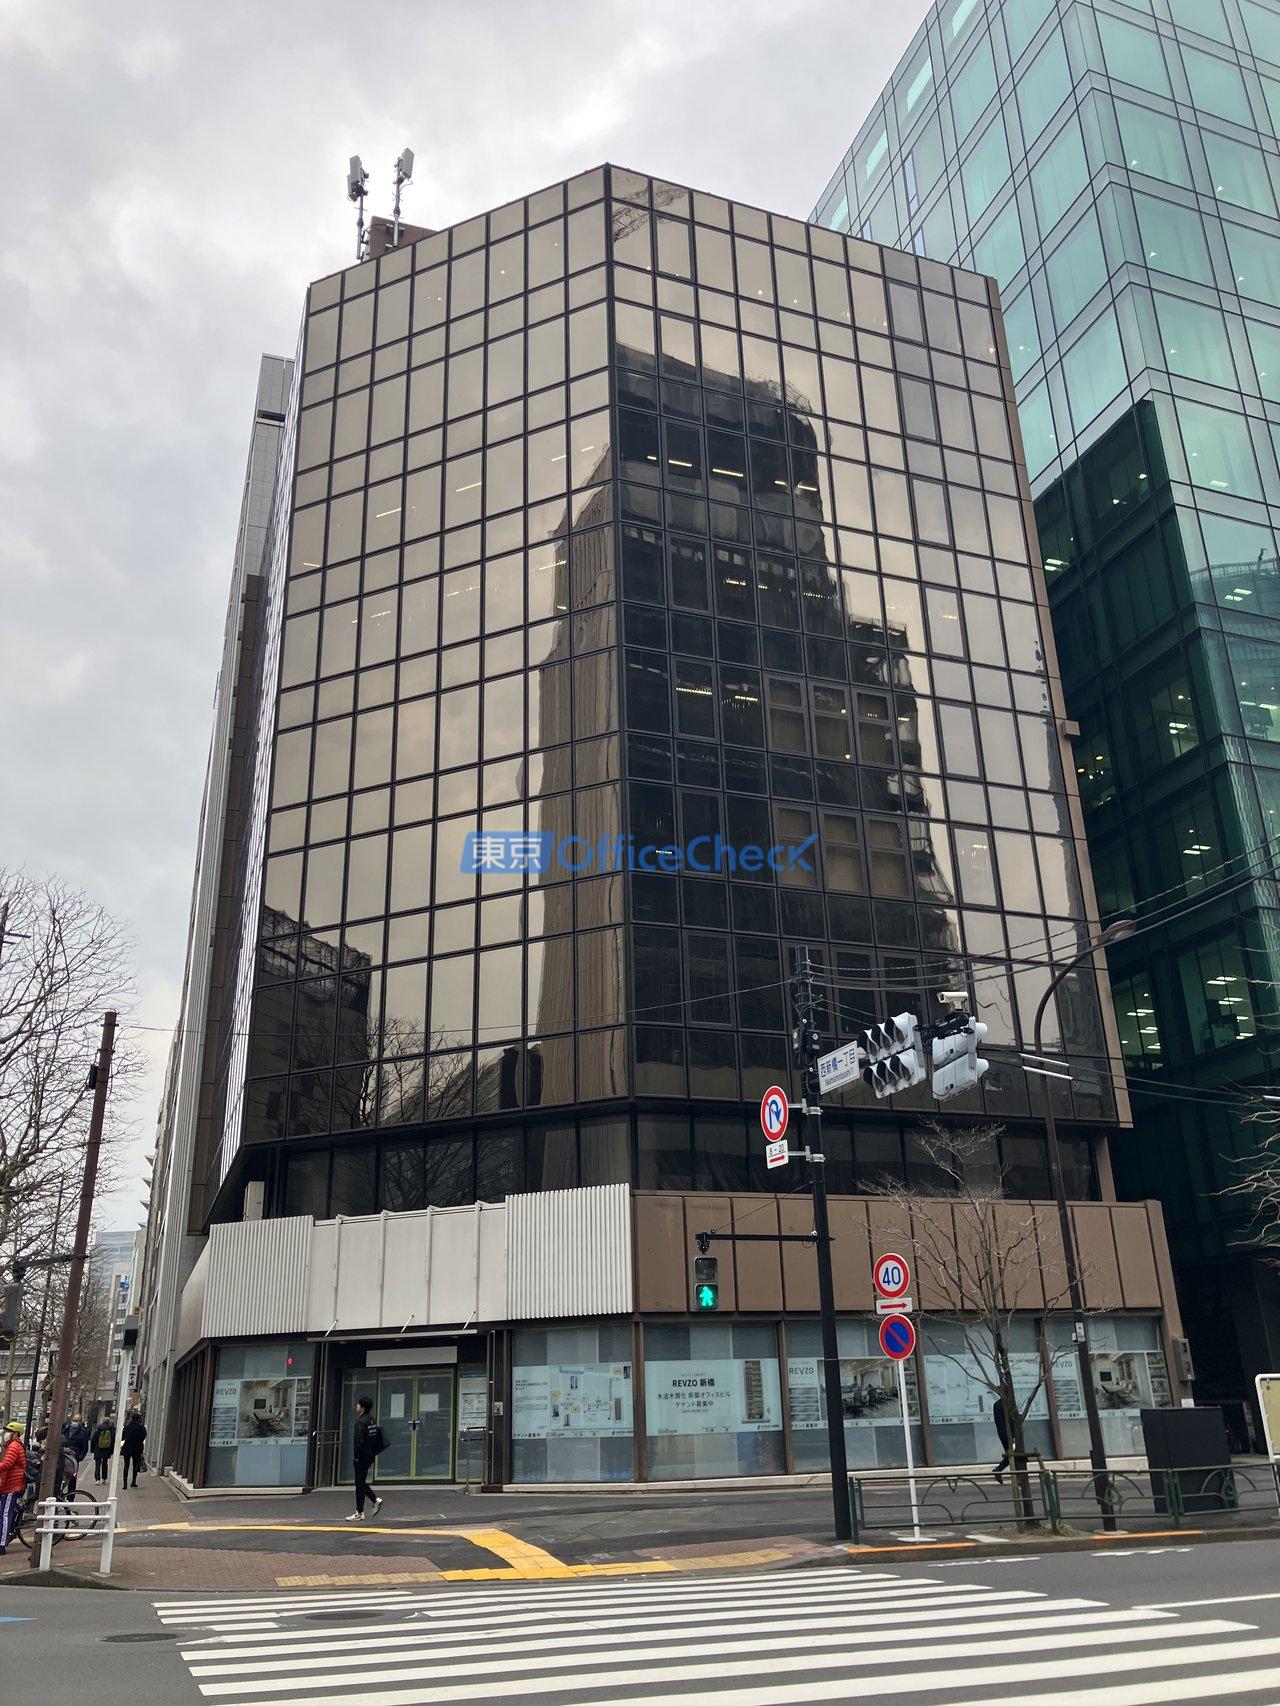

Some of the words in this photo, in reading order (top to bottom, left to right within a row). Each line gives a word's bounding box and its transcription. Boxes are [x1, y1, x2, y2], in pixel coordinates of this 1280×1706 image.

[820, 1048, 856, 1078] 西新橋一丁目
[882, 1266, 902, 1286] 40
[787, 1366, 815, 1376] REVZO
[672, 1379, 698, 1389] REVZO
[699, 1377, 716, 1388] 新橋
[216, 1387, 238, 1397] REVZO
[674, 1400, 715, 1409] テナント募集中
